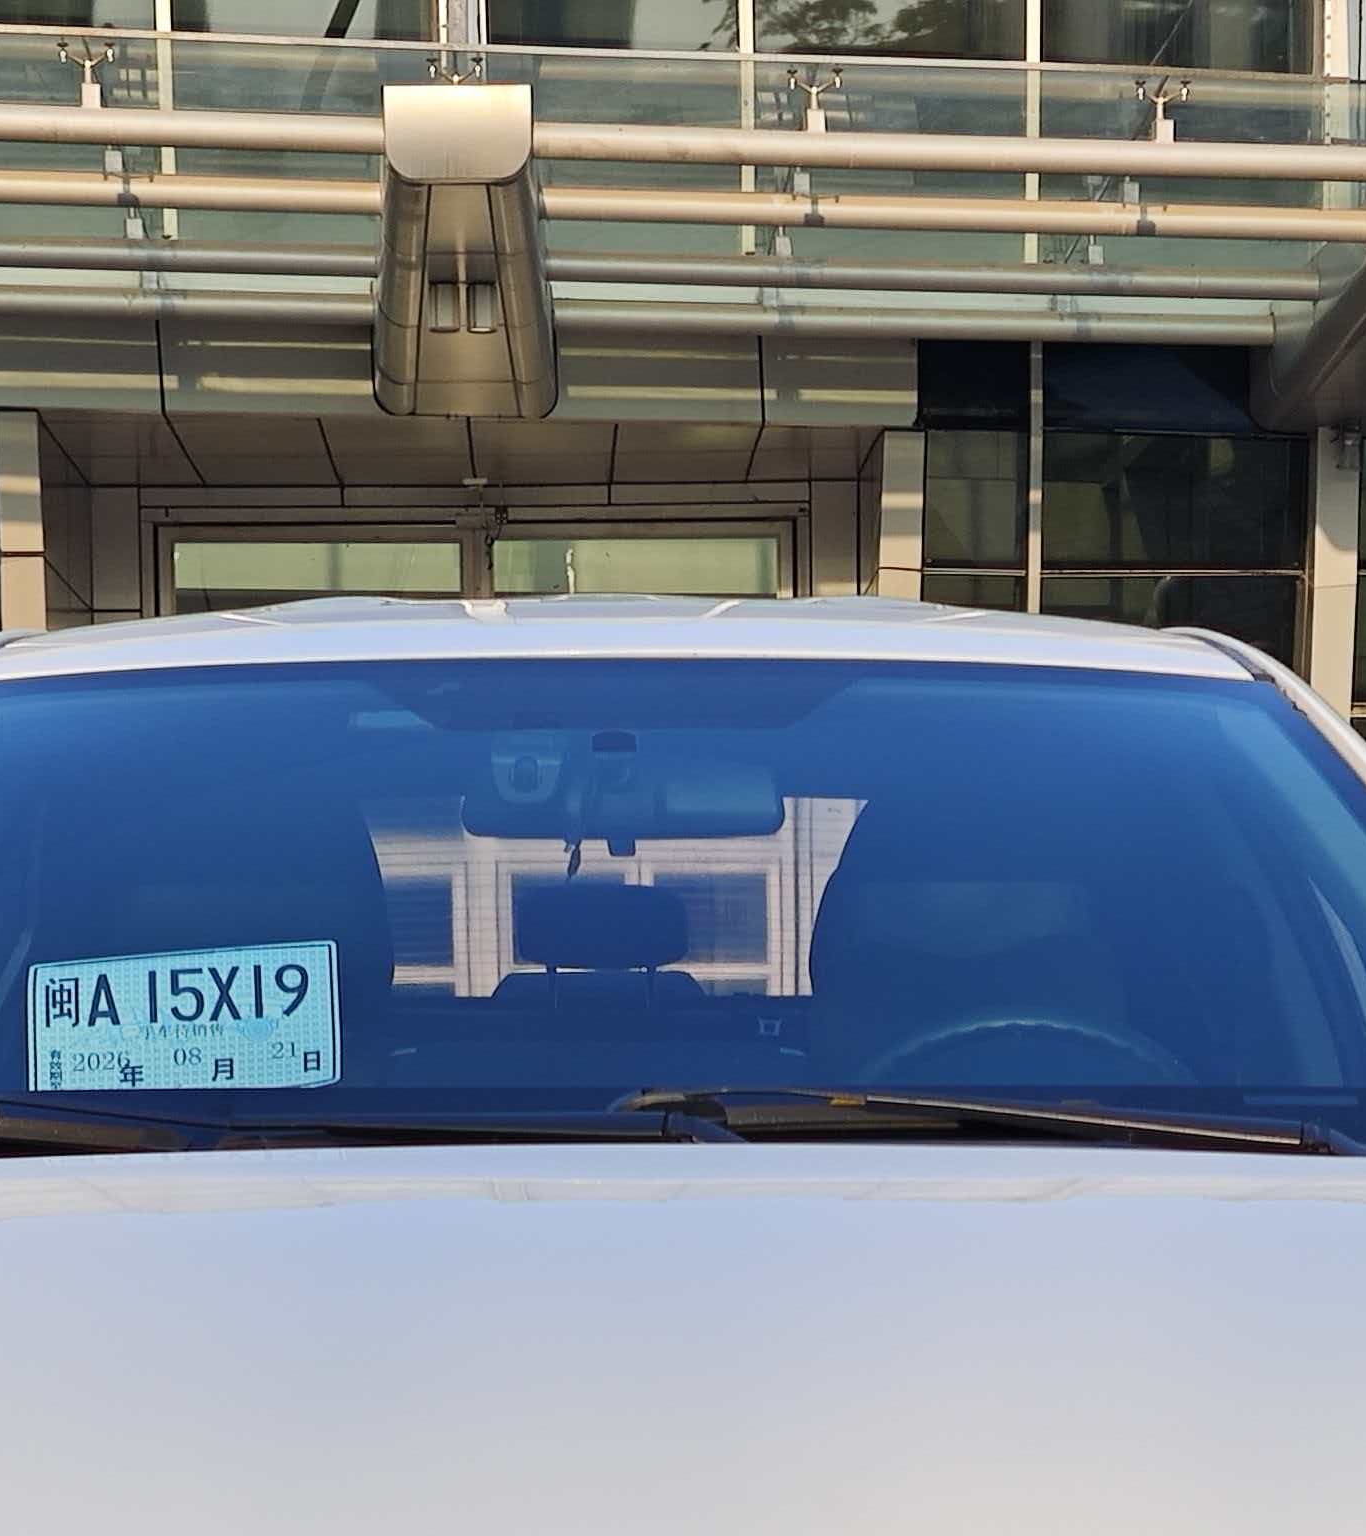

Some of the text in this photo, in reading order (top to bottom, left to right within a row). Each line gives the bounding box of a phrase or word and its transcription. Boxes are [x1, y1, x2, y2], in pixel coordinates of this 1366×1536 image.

[45, 964, 310, 1028] 闽A 15X19
[120, 1065, 144, 1087] 年
[173, 1047, 202, 1066] 08
[211, 1058, 235, 1081] 月
[271, 1041, 297, 1060] 21
[303, 1051, 322, 1073] 日
